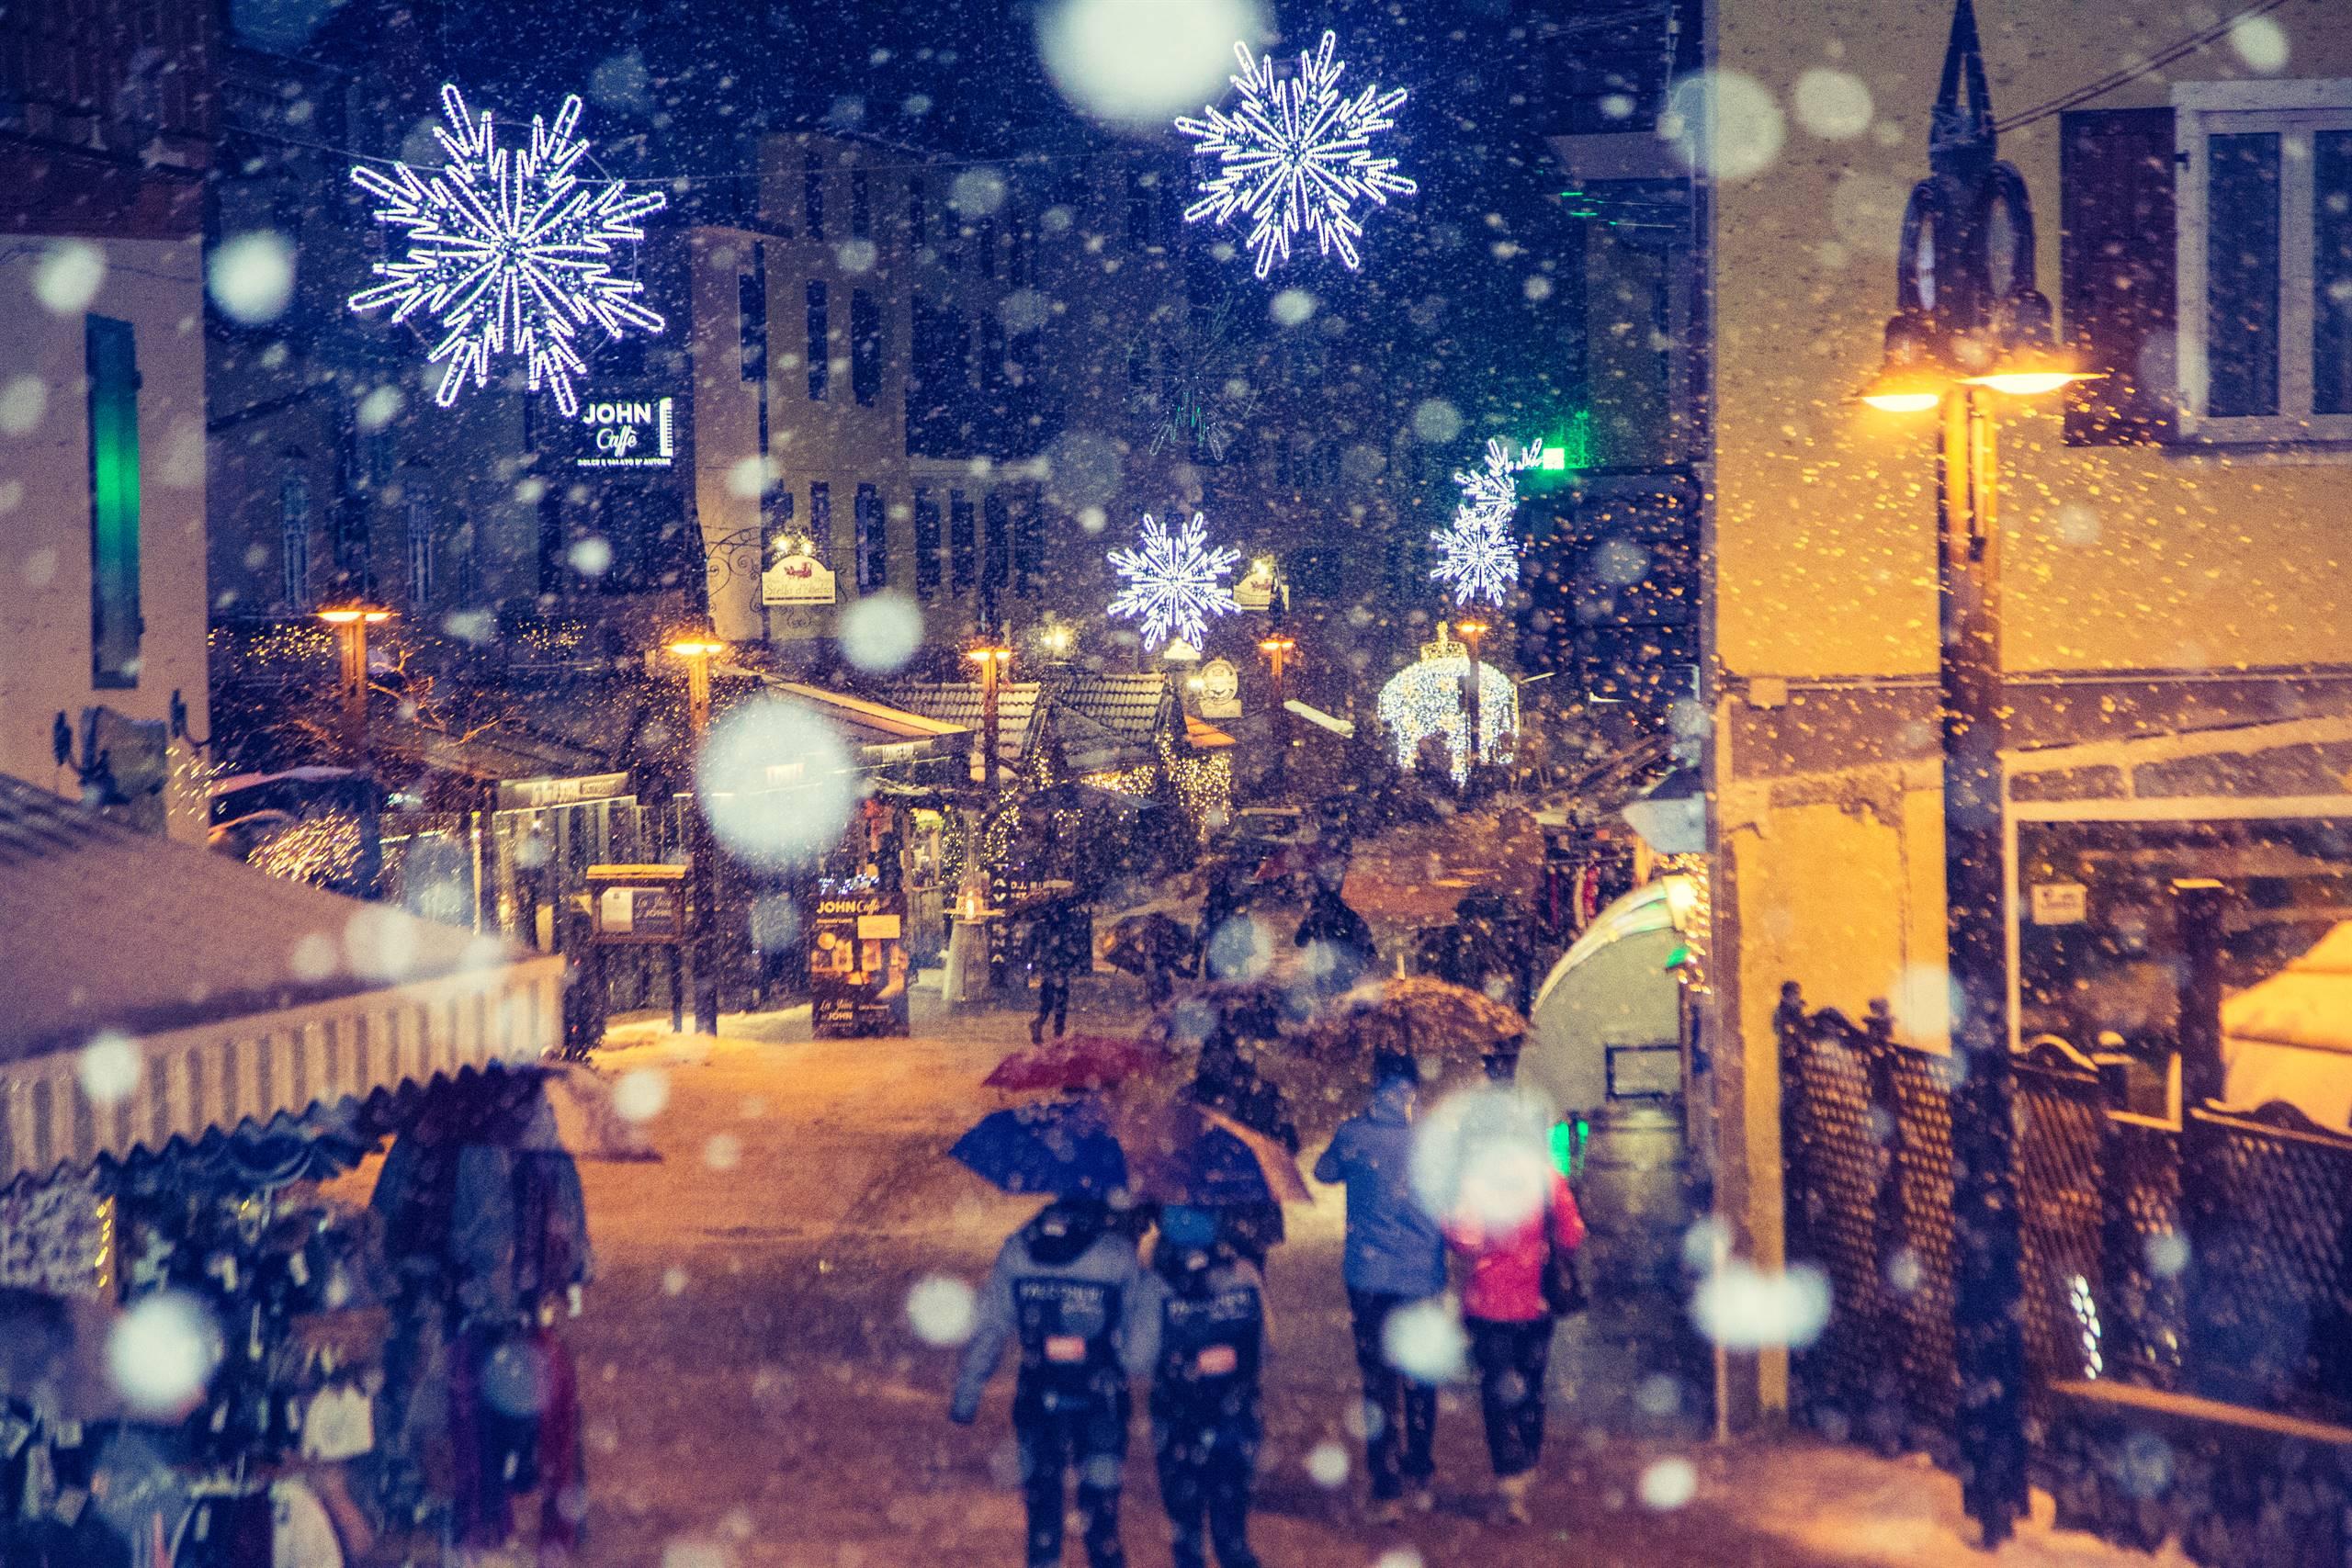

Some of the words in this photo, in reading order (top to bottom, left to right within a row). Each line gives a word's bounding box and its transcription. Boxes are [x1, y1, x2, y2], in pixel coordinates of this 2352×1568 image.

[582, 402, 650, 423] JOHN
[816, 900, 856, 914] JOHN
[991, 863, 1009, 964] TAVRNA
